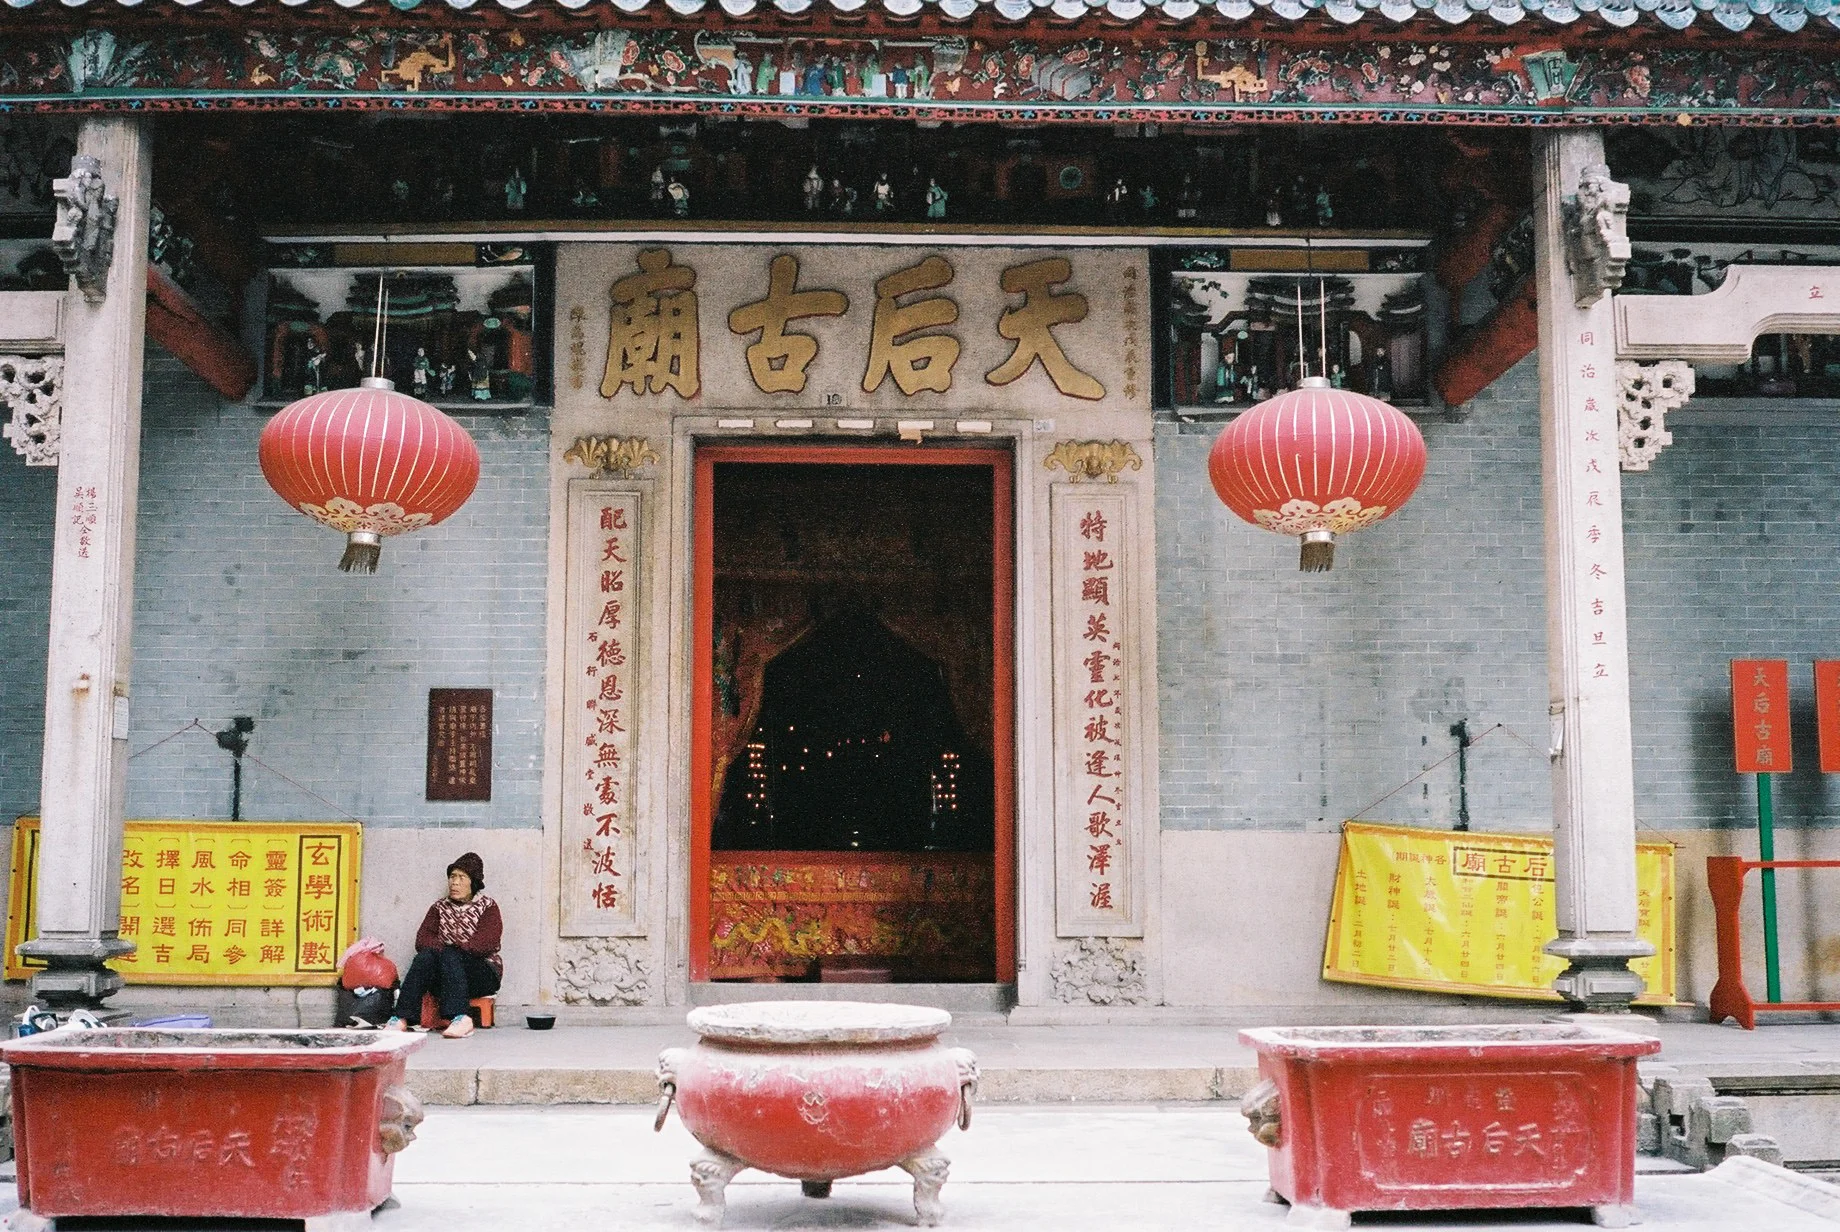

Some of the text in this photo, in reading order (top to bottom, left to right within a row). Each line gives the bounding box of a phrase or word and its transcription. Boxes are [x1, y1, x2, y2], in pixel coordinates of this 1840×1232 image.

[599, 248, 1107, 400] 天后古廟
[1809, 285, 1824, 299] 立
[1753, 667, 1773, 766] 天后古廟
[301, 842, 336, 965] 玄學術數
[1407, 1117, 1547, 1159] 天后古廟
